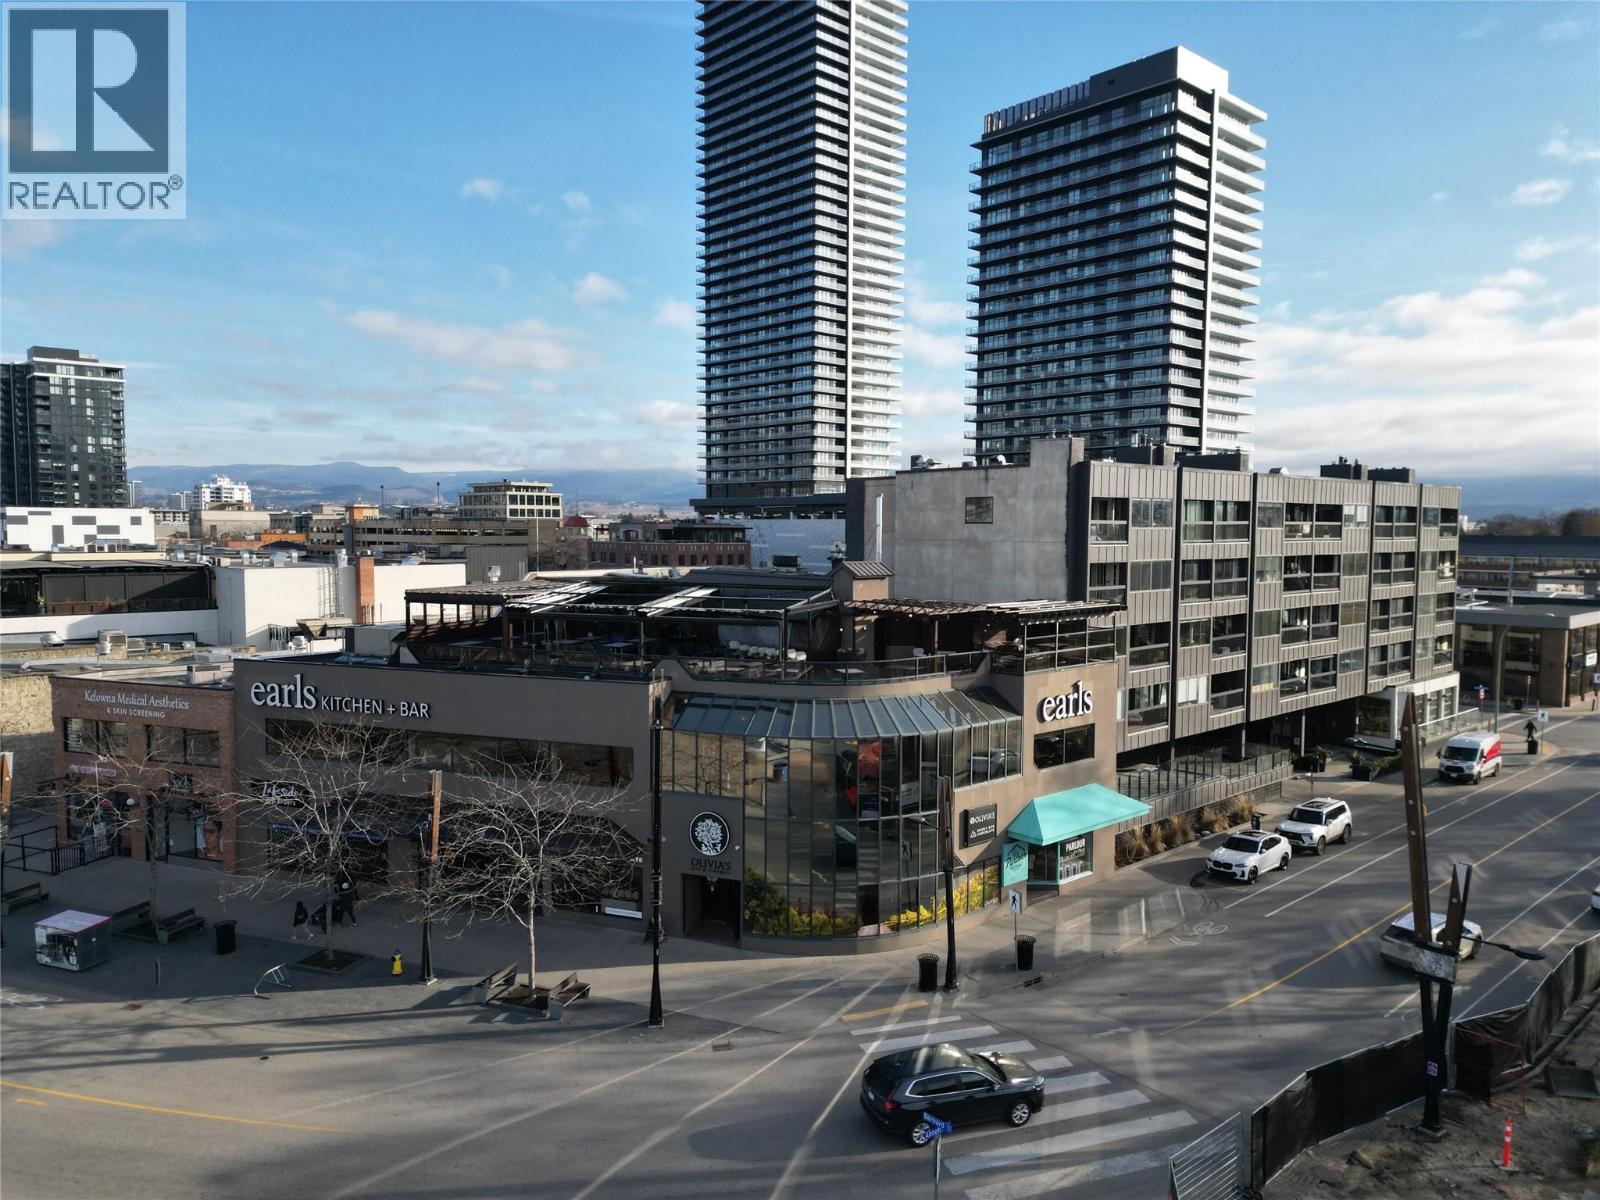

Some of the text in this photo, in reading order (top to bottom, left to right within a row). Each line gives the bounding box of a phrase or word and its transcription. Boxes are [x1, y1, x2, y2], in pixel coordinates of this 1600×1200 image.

[84, 689, 190, 710] Kelowna Medical Aesthetics
[250, 673, 317, 710] earls
[321, 696, 383, 714] KITCHEN
[400, 701, 429, 718] BAR
[1042, 680, 1093, 722] earls
[113, 707, 128, 715] SKIN
[129, 708, 166, 719] SCREENING
[691, 858, 732, 872] OLIVIA'S
